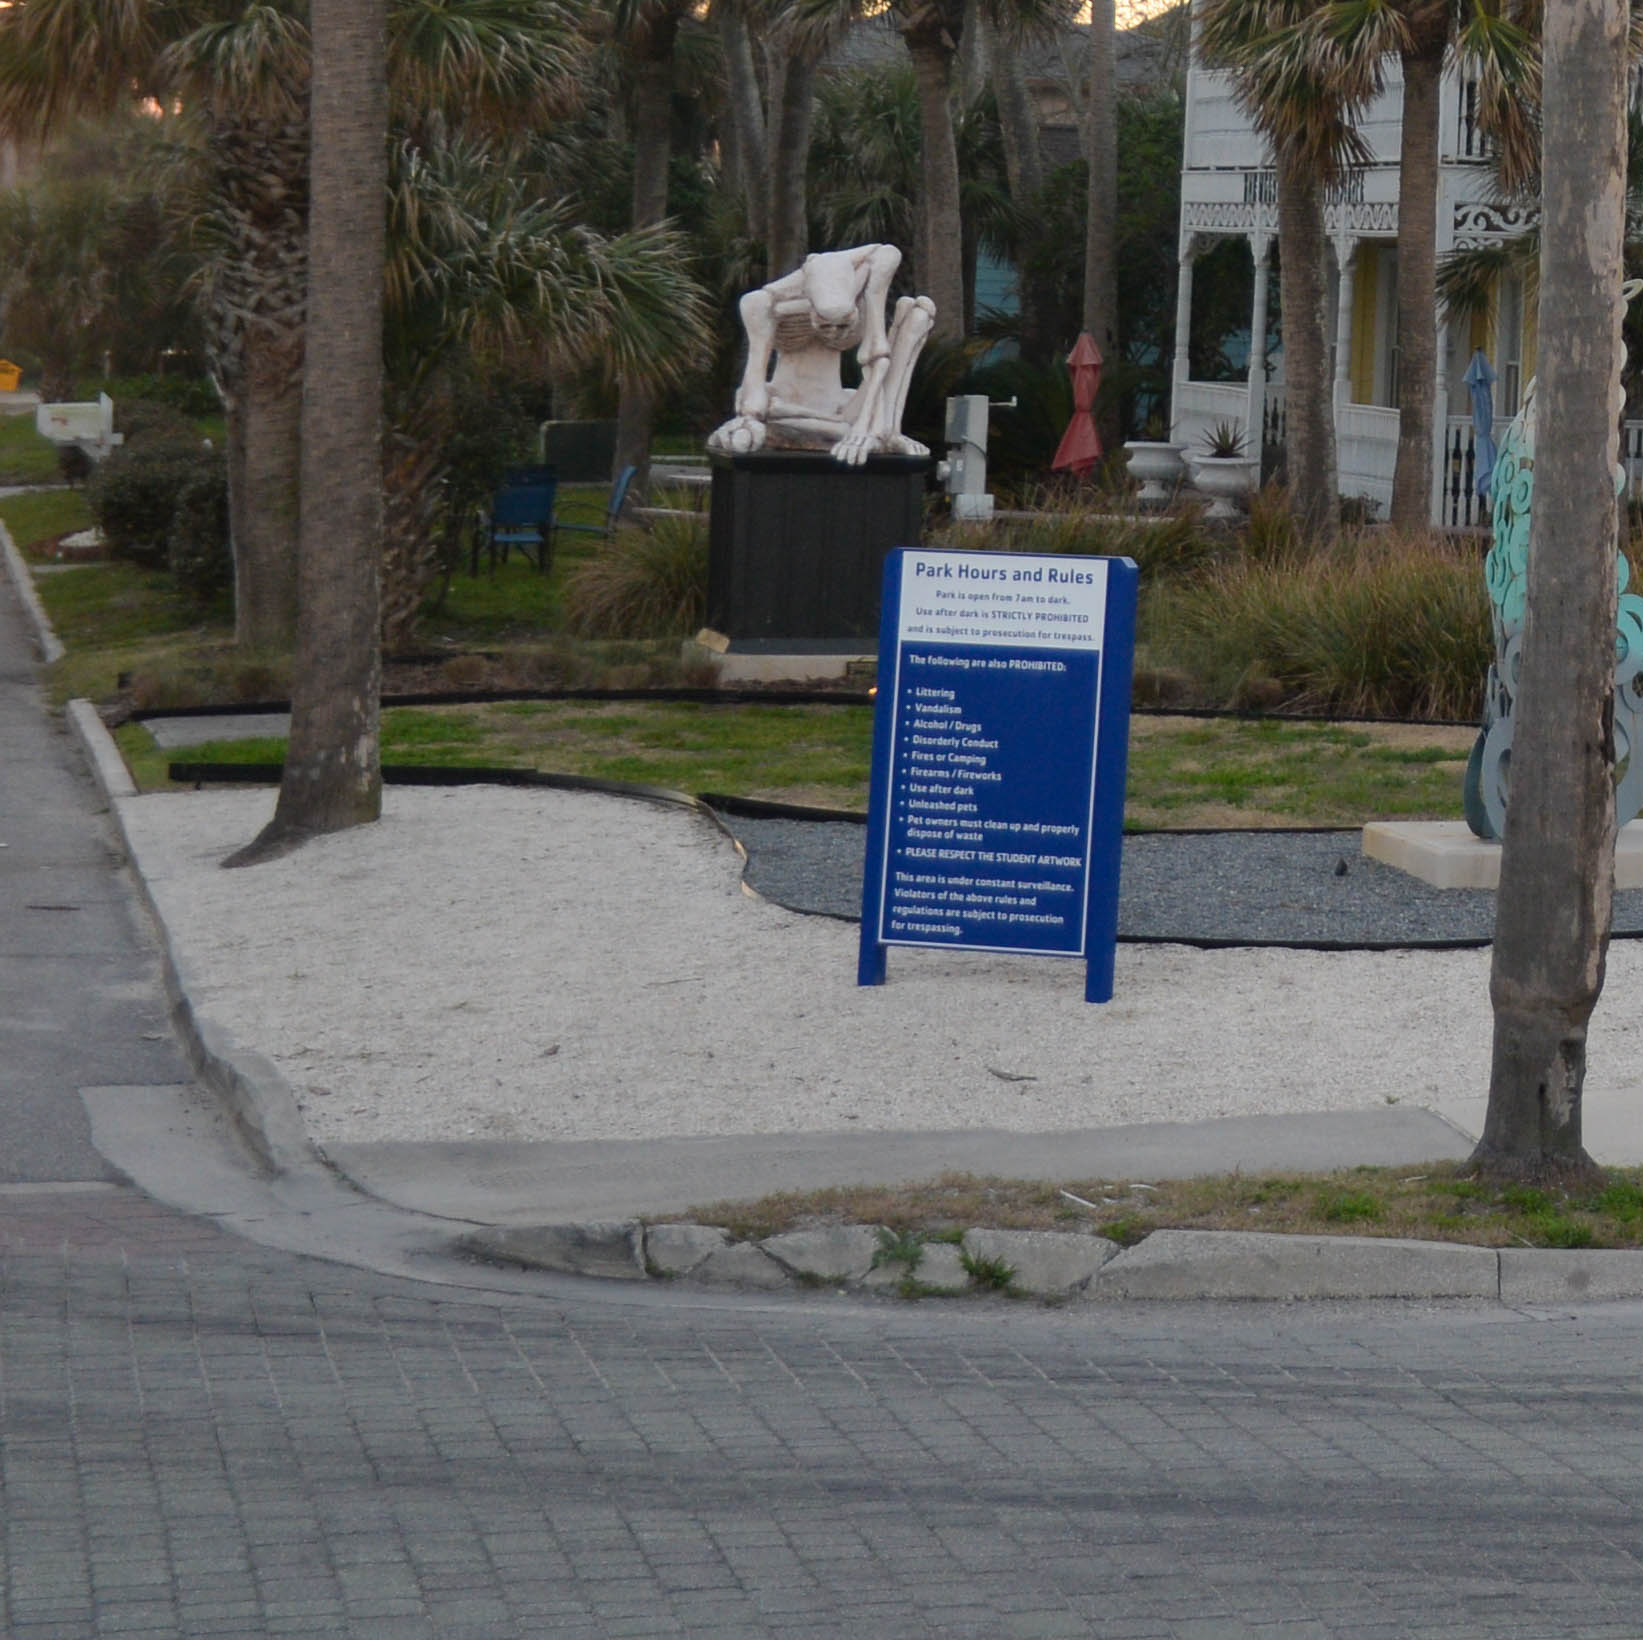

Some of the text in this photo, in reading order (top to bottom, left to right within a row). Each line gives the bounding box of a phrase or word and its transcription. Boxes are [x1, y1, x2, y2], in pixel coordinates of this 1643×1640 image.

[915, 563, 1093, 584] Park Hours and Rules
[967, 594, 990, 602] open
[1016, 594, 1034, 602] 7am
[991, 611, 1032, 620] STRICTLY
[1035, 613, 1089, 622] PROHIBITED
[935, 627, 969, 636] subject
[982, 630, 1036, 638] prosecution
[1038, 631, 1051, 639] for
[910, 655, 926, 664] The
[927, 656, 970, 668] following
[988, 660, 1008, 668] also
[1008, 660, 1066, 671] PROHIBITED:
[916, 688, 955, 699] Littering
[915, 704, 962, 713] Vandalism
[913, 720, 948, 729] Alcohol
[954, 722, 982, 733] Drugs
[912, 736, 999, 748] Disorderly Conduct
[911, 751, 934, 760] Fires
[947, 753, 987, 765] Camping
[910, 767, 950, 777] Firearms
[957, 770, 1002, 780] Fireworks
[909, 784, 974, 795] Use after dark
[908, 800, 978, 812] Unleashed pets
[907, 815, 924, 824] Pet
[983, 820, 1009, 829] clean
[1009, 824, 1022, 832] up
[1022, 823, 1041, 831] and
[1040, 825, 1080, 835] properly
[907, 828, 943, 839] dispose
[944, 830, 955, 838] of
[905, 848, 1082, 866] PLEASE RESPECT THE STUDENT ARTWORK
[895, 872, 915, 881] This
[946, 876, 974, 885] under
[974, 879, 1016, 887] constant
[1016, 881, 1075, 891] surveillance.
[894, 889, 1037, 905] Violators of the above rules and
[892, 906, 944, 917] regulations
[962, 910, 996, 921] subject
[996, 912, 1009, 920] to
[1008, 914, 1064, 923] prosecution
[891, 920, 963, 935] for trespassing.
